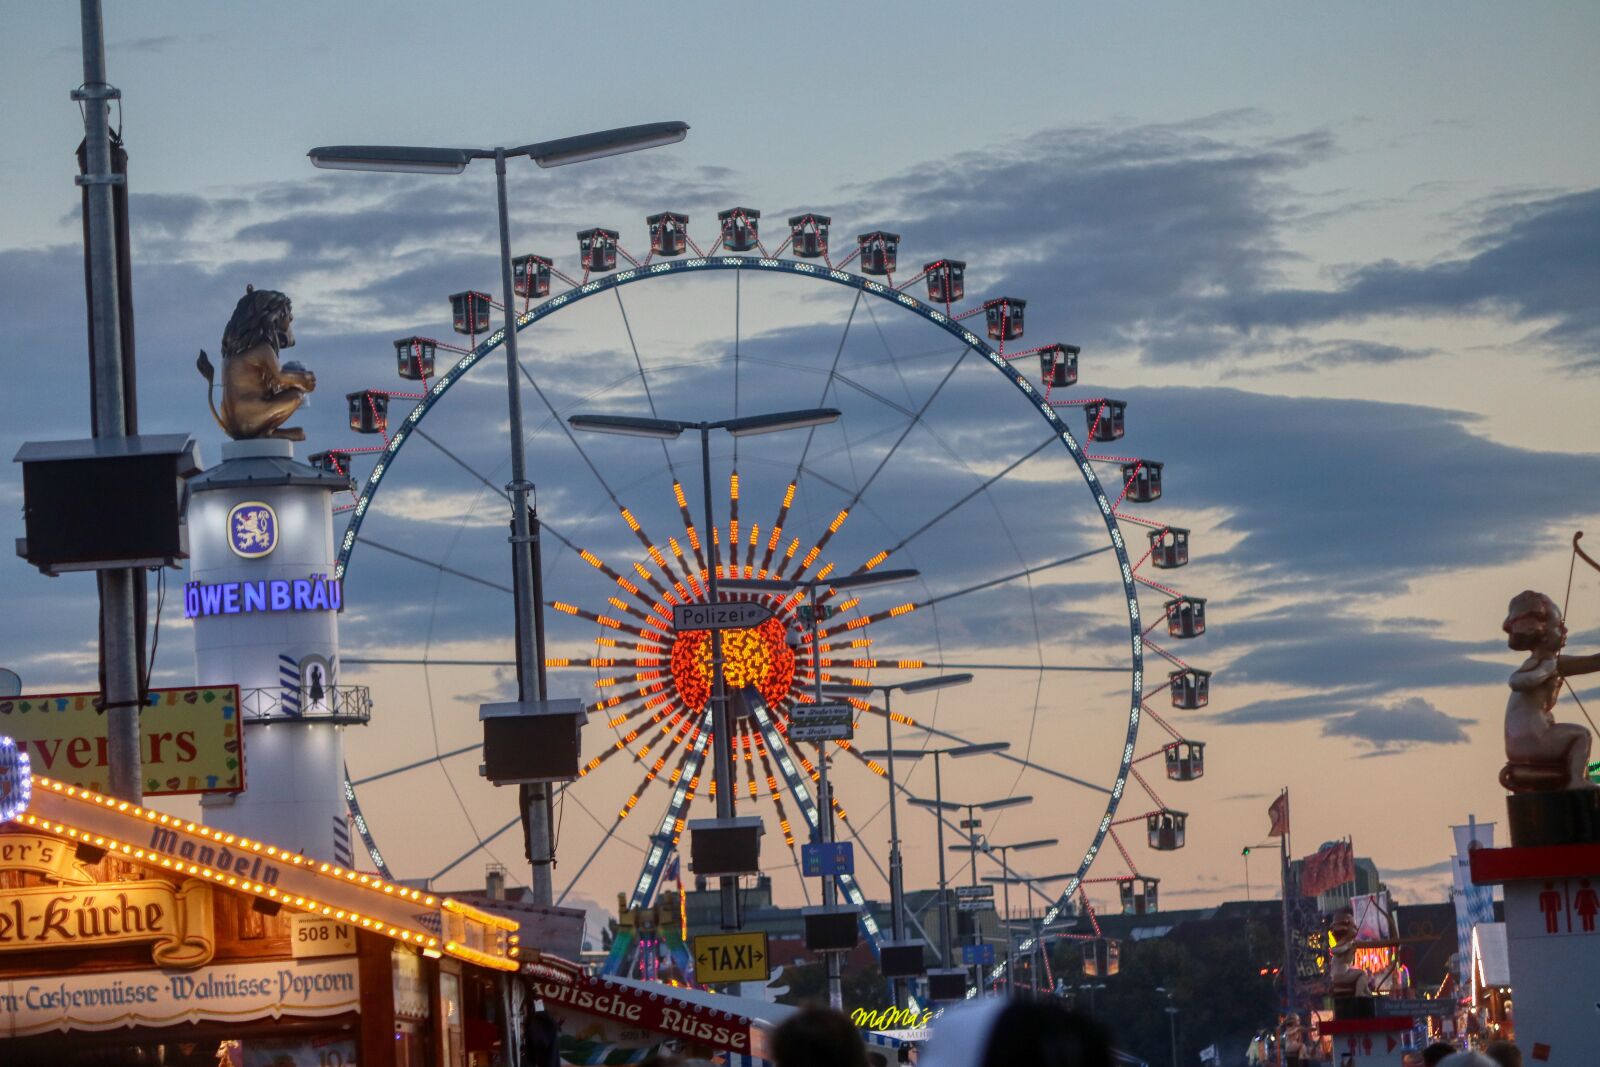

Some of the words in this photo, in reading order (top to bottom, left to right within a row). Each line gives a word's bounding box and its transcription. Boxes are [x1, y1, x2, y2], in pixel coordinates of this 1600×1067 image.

[683, 606, 745, 625] Polizei
[150, 825, 280, 886] Mandeln
[298, 925, 329, 942] 508
[335, 924, 348, 940] N
[708, 944, 753, 970] TAXI
[170, 971, 272, 999] Walnüsse
[277, 969, 354, 1002] Popcorn
[659, 1007, 747, 1049] Nüsse
